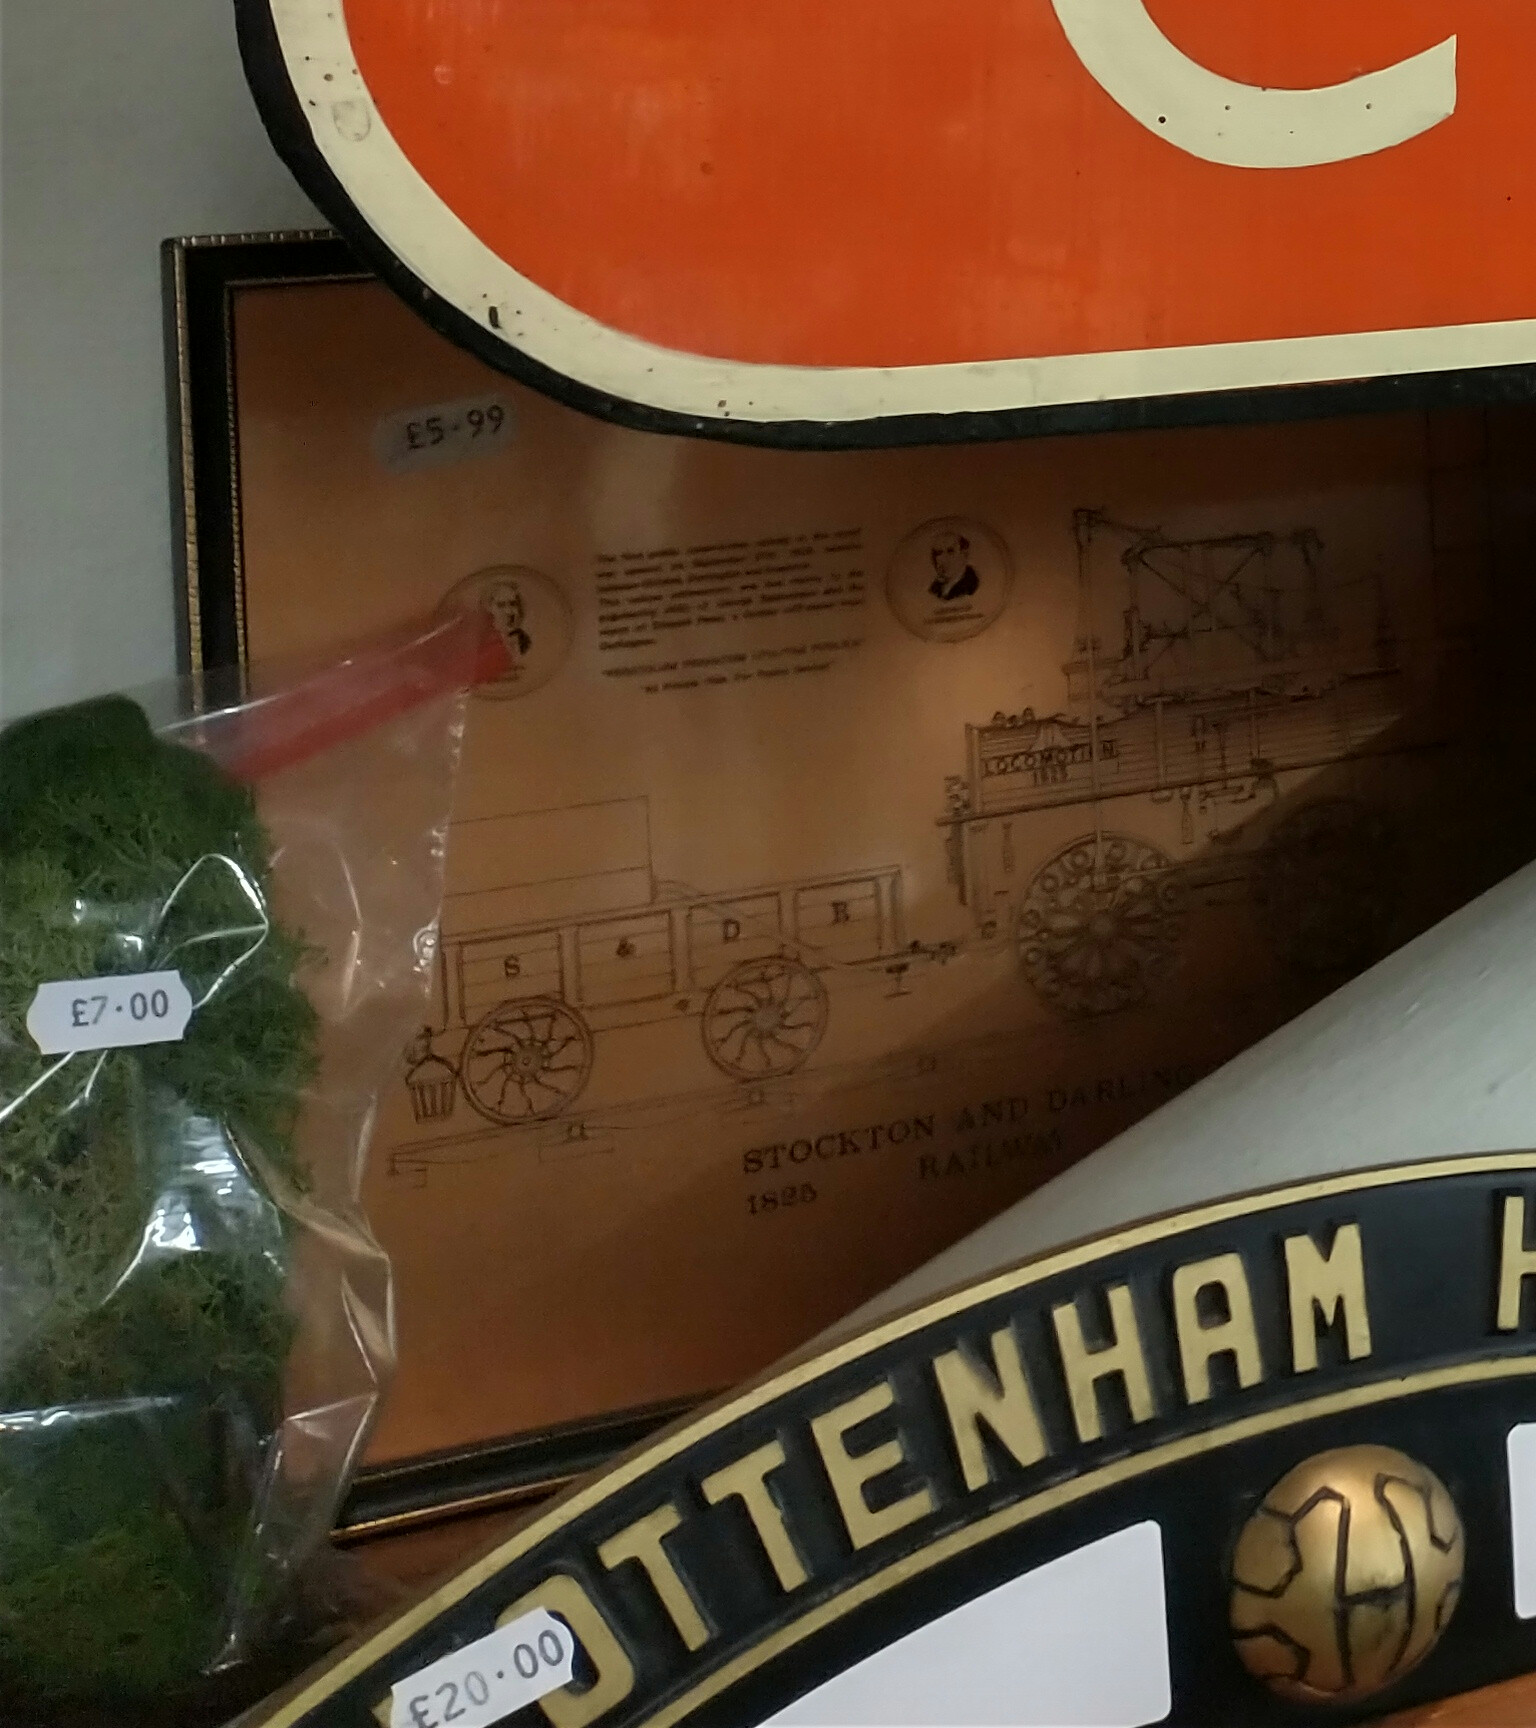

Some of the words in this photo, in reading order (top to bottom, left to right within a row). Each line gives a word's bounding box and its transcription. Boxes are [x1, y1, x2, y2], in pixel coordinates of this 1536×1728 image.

[722, 918, 741, 943] D
[743, 1114, 935, 1175] STOCKTON
[956, 1096, 1029, 1132] AND
[372, 1222, 1372, 1728] OTTENHAM
